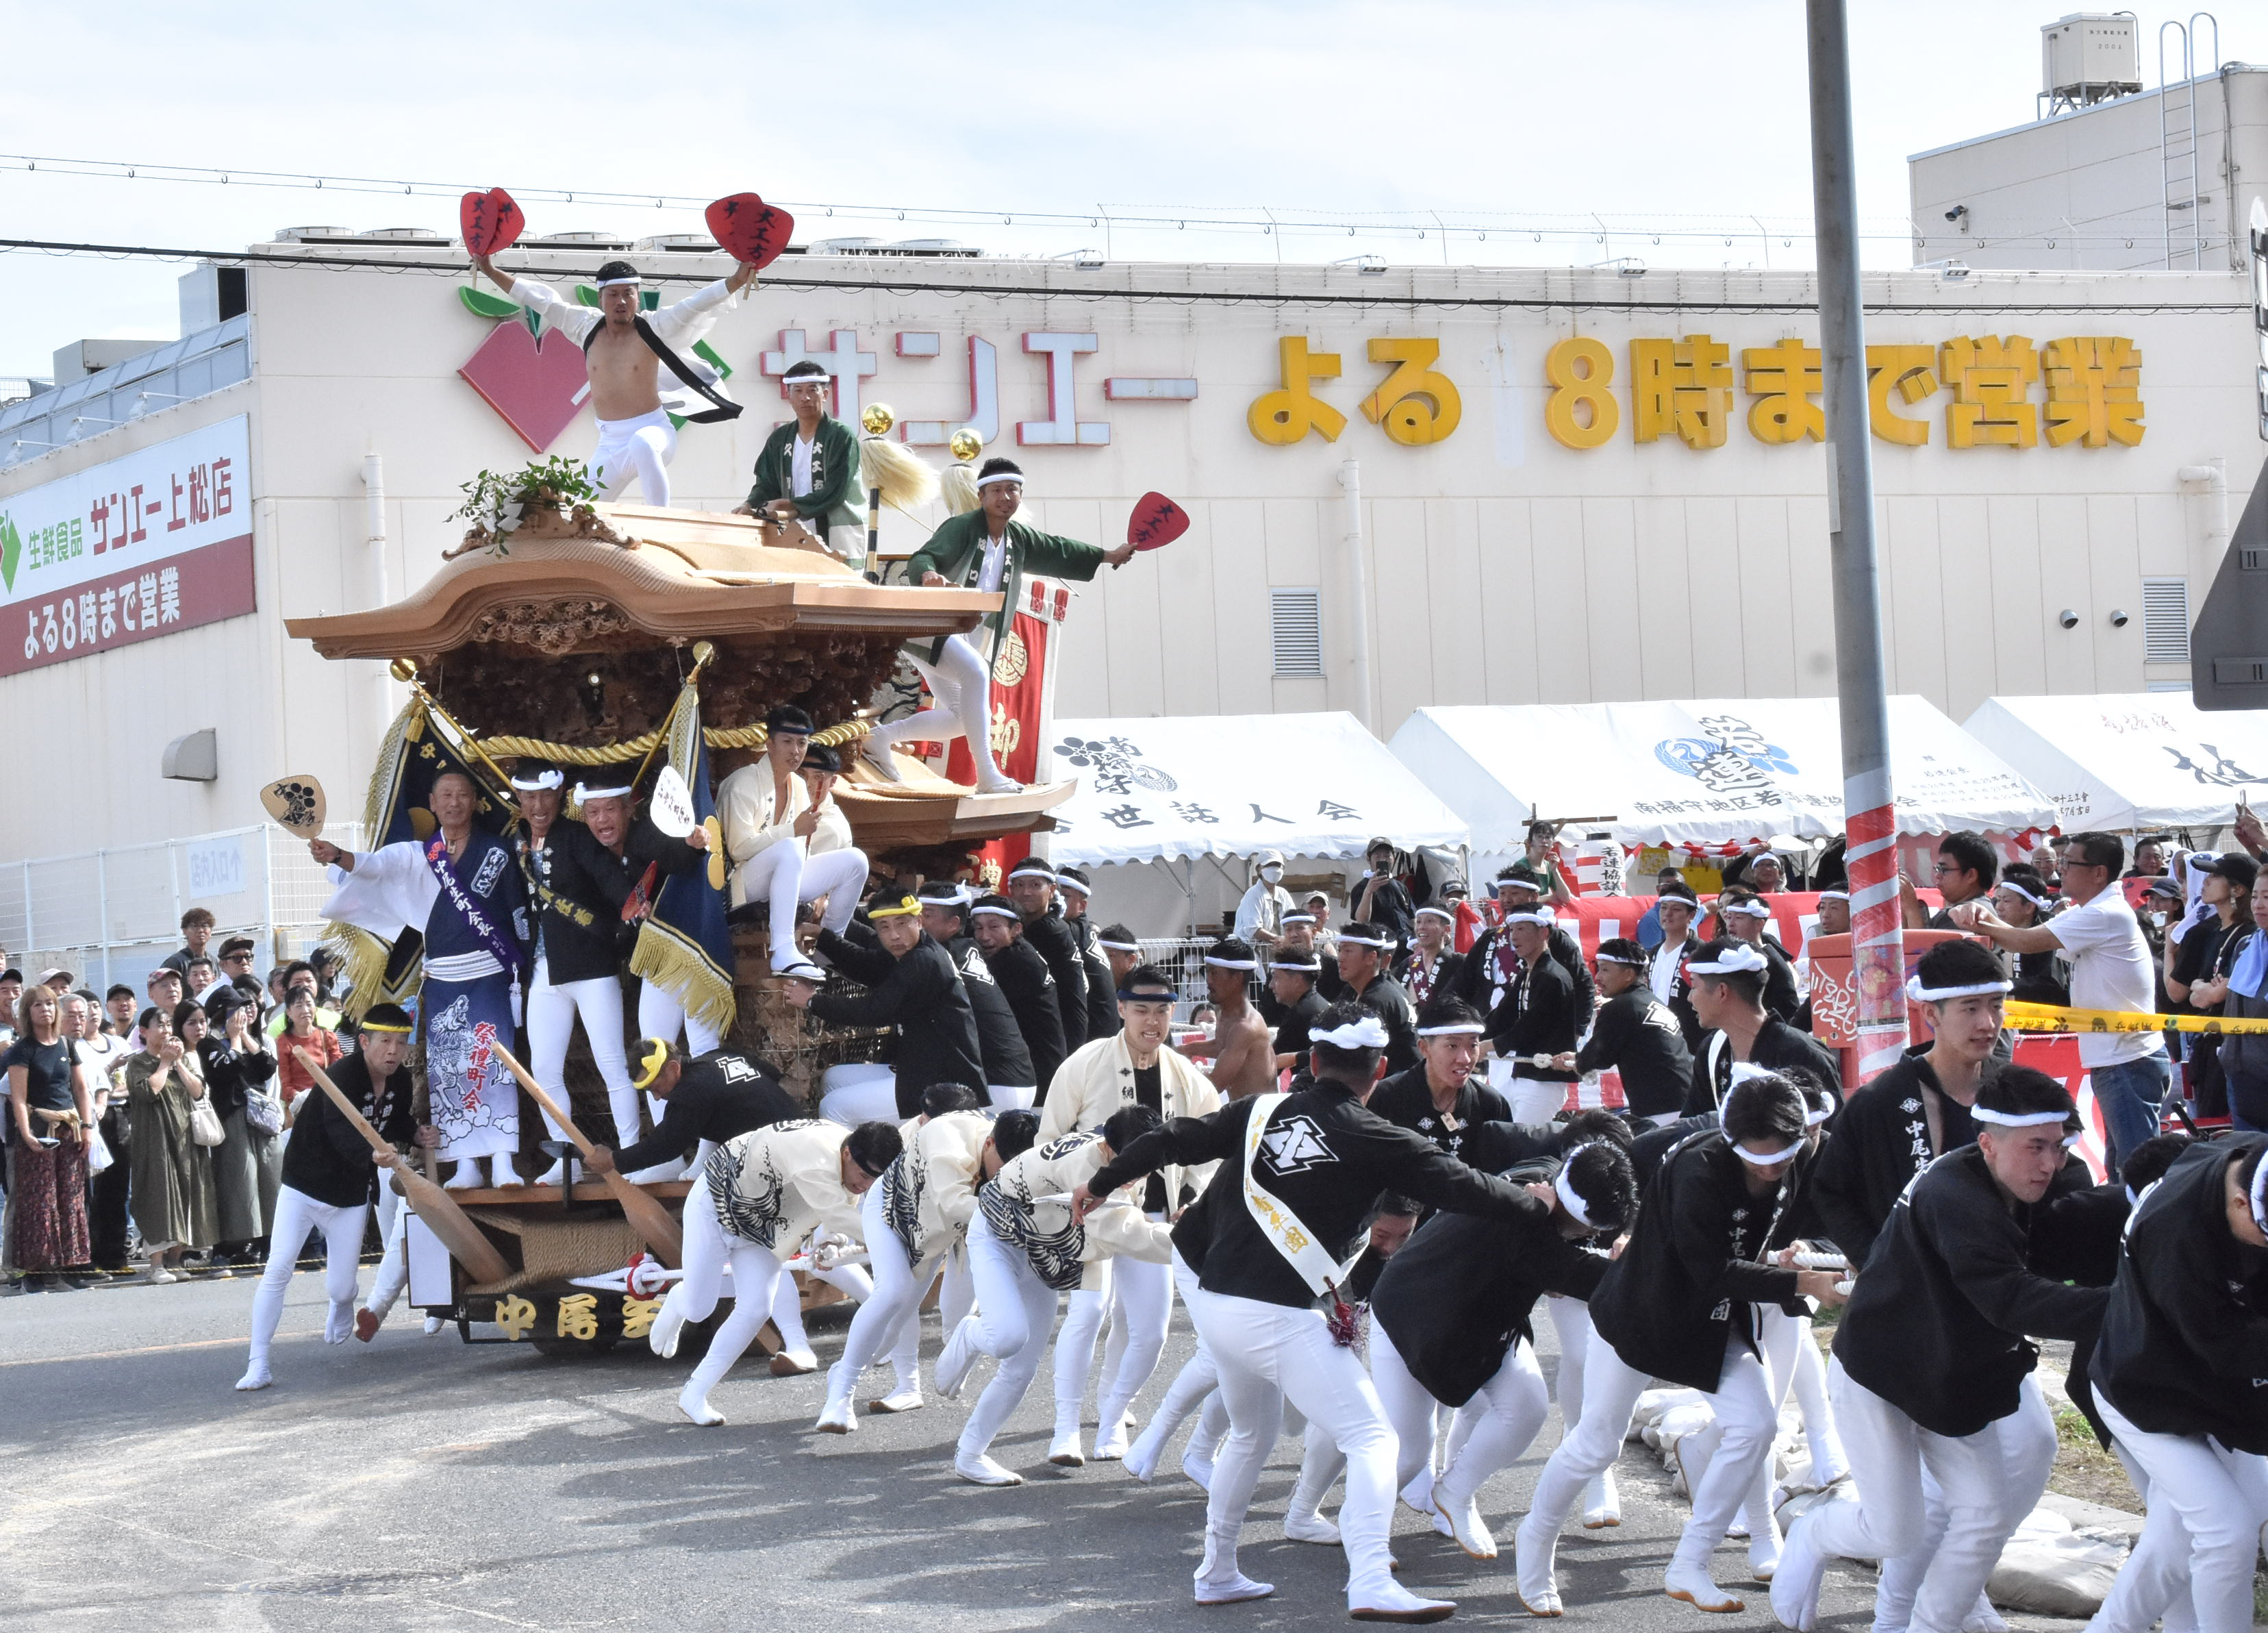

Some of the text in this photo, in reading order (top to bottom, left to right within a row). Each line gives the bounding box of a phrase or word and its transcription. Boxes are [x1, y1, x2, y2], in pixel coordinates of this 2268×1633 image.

[759, 329, 1198, 446] サンエー
[1247, 334, 2147, 449] よる 8時まで営業
[29, 517, 83, 570] 生鮮食品
[24, 566, 180, 659] よる8時まで営業
[2047, 792, 2089, 804] 四十三年會
